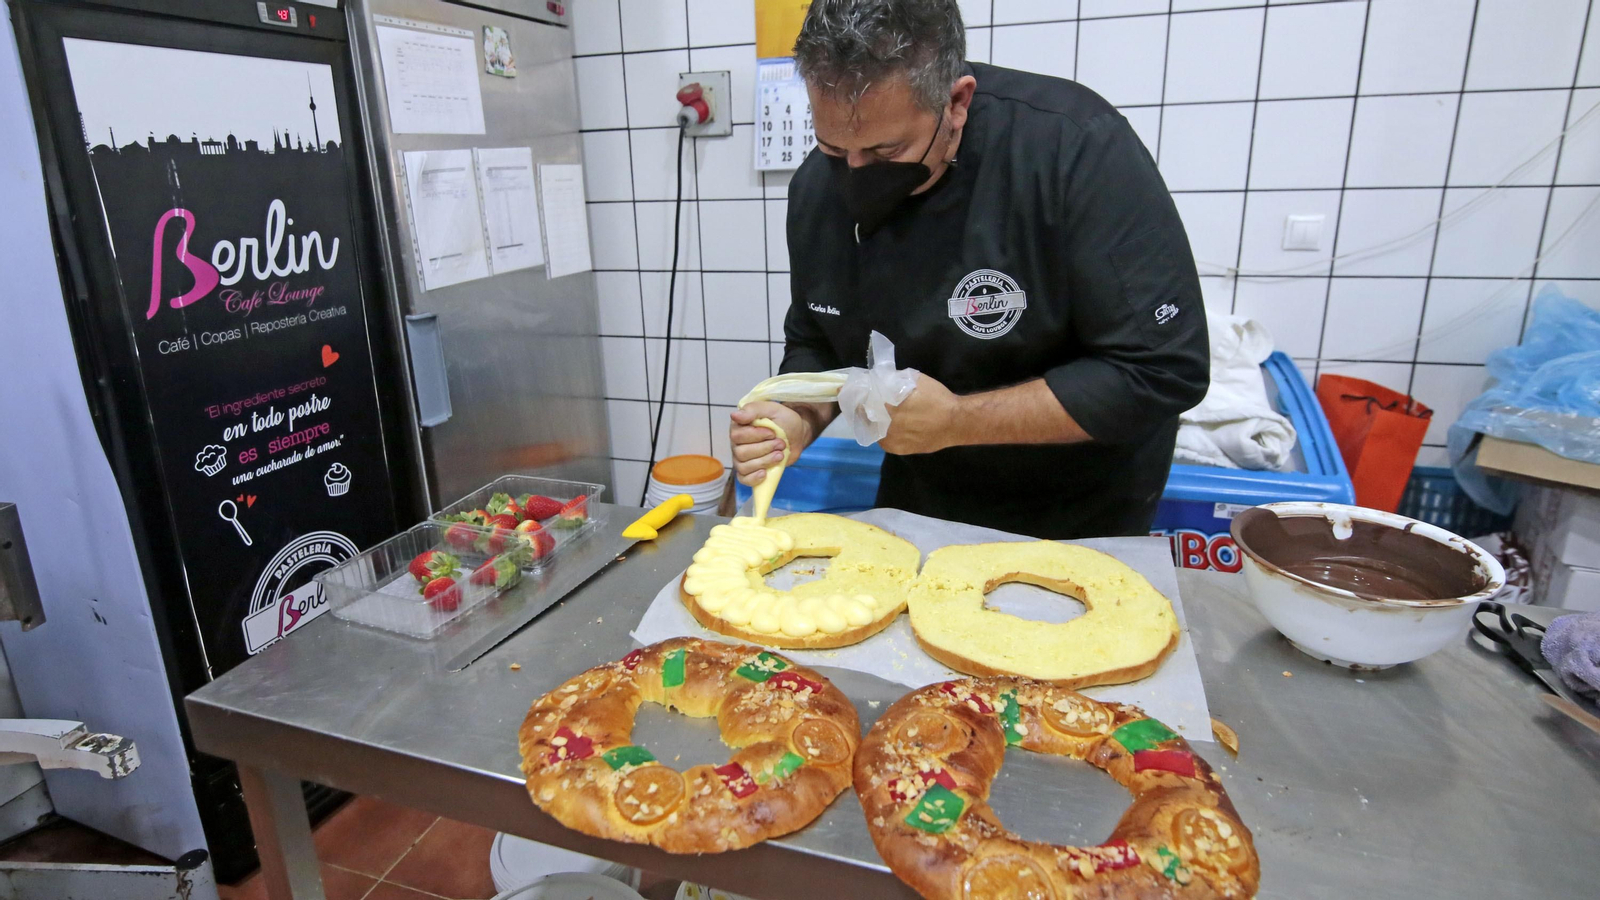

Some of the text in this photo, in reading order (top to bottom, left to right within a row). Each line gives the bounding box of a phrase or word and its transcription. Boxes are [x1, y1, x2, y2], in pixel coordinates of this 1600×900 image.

[762, 120, 814, 132] 10 11 12
[764, 104, 770, 116] 3
[785, 104, 791, 115] 4
[762, 135, 814, 147] 17 18 19
[782, 152, 793, 162] 25
[146, 199, 340, 320] Berlin
[219, 281, 325, 318] Café Lounge
[965, 295, 1009, 315] Berlin
[158, 304, 347, 355] Café Copas Repostería Creativa
[222, 387, 286, 416] ingrediente
[288, 375, 327, 395] secreto
[222, 393, 332, 442] en todo postre
[238, 421, 330, 465] es siempre
[231, 471, 254, 486] una
[255, 450, 304, 478] cucharada
[304, 445, 316, 460] de
[273, 541, 332, 580] PASTELERÍA
